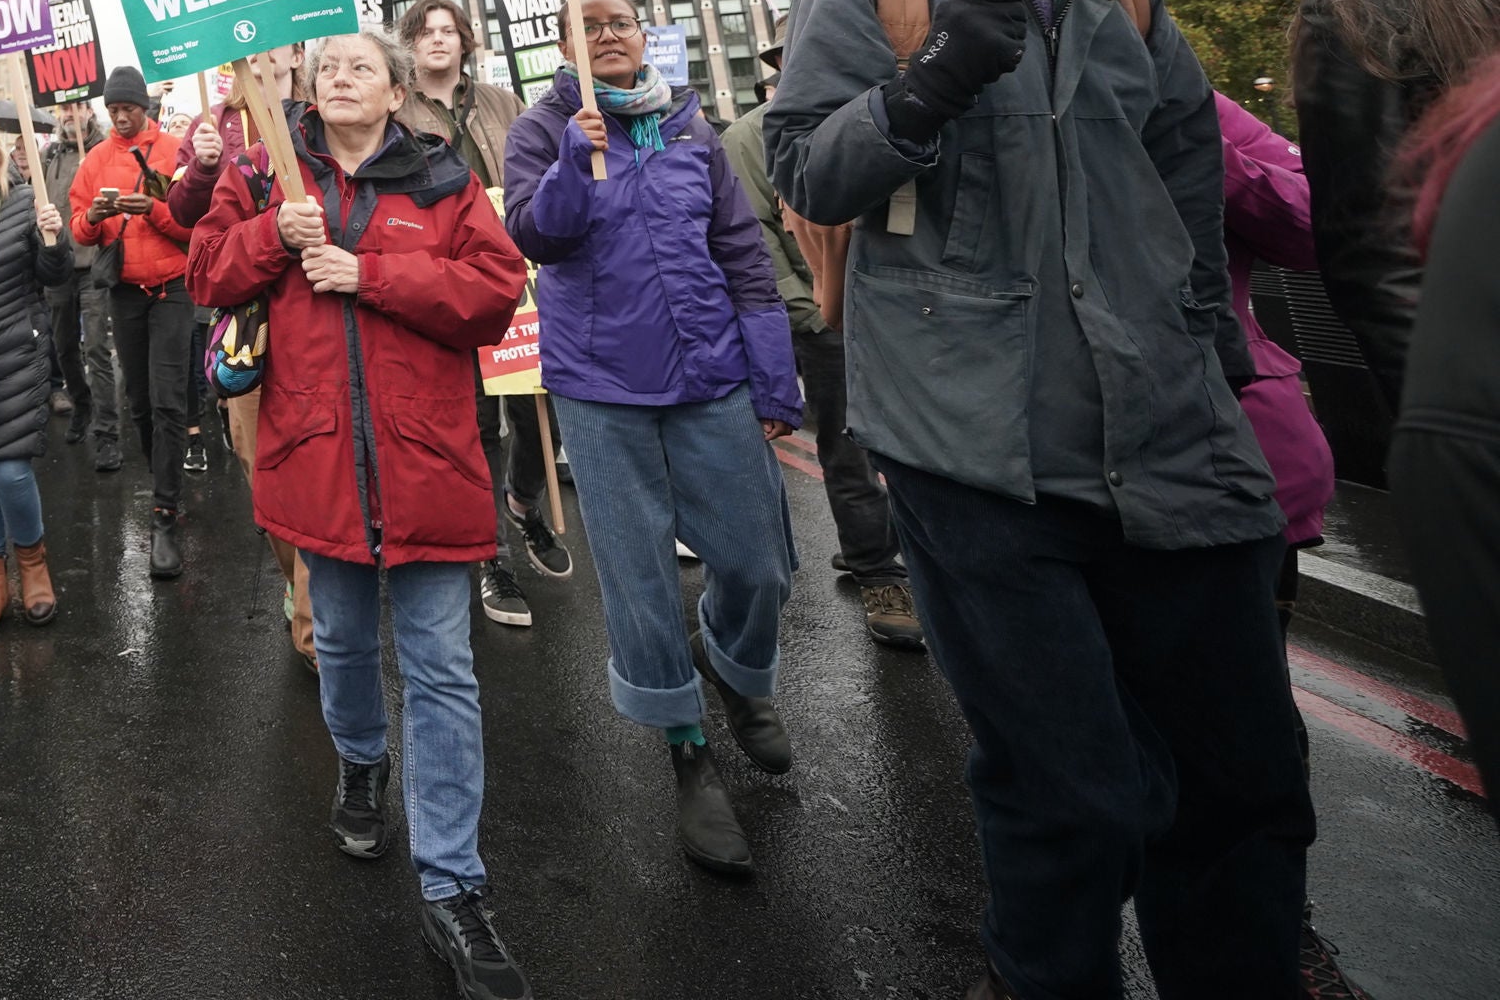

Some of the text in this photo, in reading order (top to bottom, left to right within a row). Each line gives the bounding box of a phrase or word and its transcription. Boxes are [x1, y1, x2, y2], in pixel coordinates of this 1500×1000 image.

[291, 7, 343, 22] stopwar.org.uk
[508, 16, 560, 49] BILLS
[152, 40, 199, 59] Stop the War
[155, 52, 187, 65] Coalition
[33, 41, 97, 94] NOW
[492, 342, 539, 364] PROTES
